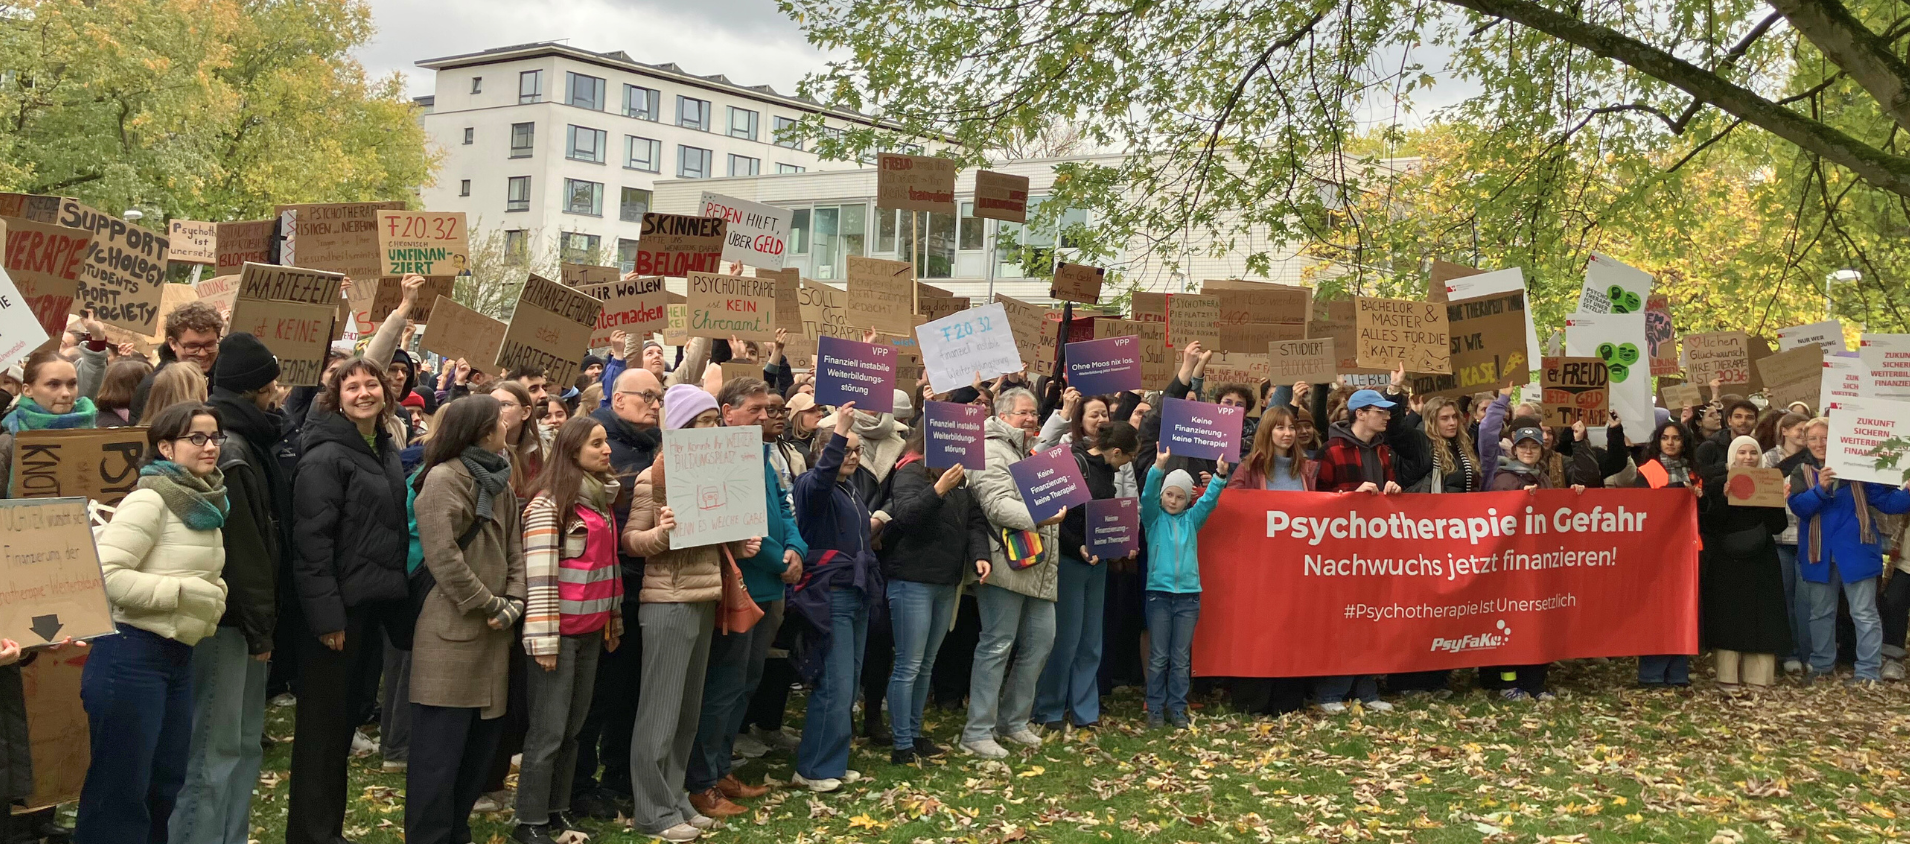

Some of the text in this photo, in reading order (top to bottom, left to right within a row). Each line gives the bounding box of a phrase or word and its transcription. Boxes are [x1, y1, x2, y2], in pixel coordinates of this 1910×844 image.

[641, 213, 722, 238] SKINNER
[705, 202, 780, 235] REDEN HILFT,
[61, 203, 169, 261] SUPPORT
[384, 215, 458, 240] F20.32
[728, 231, 784, 256] ÜBER GELD
[4, 229, 89, 280] HERAPIE
[388, 247, 453, 261] UNFINAN-
[85, 241, 166, 288] YCHOLOGY
[390, 261, 434, 275] ZIERT
[636, 250, 723, 277] BELOHNT
[246, 268, 343, 304] WARTEZEIT
[693, 275, 775, 299] PSYCHOTHERAPIE
[1586, 287, 1608, 300] PSYCHO
[727, 299, 757, 312] KEIN
[934, 299, 950, 311] dich
[1584, 292, 1611, 308] THERAPIE
[79, 301, 158, 326] SOCIETY
[1361, 300, 1414, 314] BACHELOR
[1425, 304, 1439, 323] &
[1372, 313, 1422, 328] MASTER
[275, 318, 321, 343] KEINE
[1361, 328, 1398, 343] ALLES
[1428, 332, 1447, 346] DIE
[1115, 338, 1130, 346] VPP
[1811, 335, 1824, 343] WER
[872, 347, 889, 357] VPP
[1280, 342, 1324, 357] STUDIERT
[1370, 345, 1407, 358] KATZ
[824, 354, 890, 372] Finanziell instabile
[1071, 363, 1091, 371] Ohne
[1091, 361, 1110, 369] Moos
[1110, 358, 1121, 366] nix
[1281, 359, 1326, 377] BLOCKIERT
[1690, 362, 1710, 373] IHRE
[827, 368, 885, 385] Weiterbildungs-
[1714, 369, 1748, 383] 2036
[841, 384, 869, 396] störung
[1576, 391, 1605, 406] GELD
[965, 407, 978, 416] VPP
[1217, 407, 1235, 415] VPP
[1557, 407, 1607, 425] THERAPIE
[929, 418, 980, 431] Finanziell instabile
[1191, 416, 1213, 425] Keine
[1856, 417, 1896, 428] ZUKUNFT
[933, 431, 977, 443] Weiterbildungs-
[1174, 424, 1222, 438] Finanzierung
[1853, 427, 1890, 438] SICHERN
[1172, 434, 1228, 448] keine Therapie!
[944, 445, 966, 456] störung
[1049, 448, 1063, 459] VPP
[1036, 468, 1055, 479] Keine
[1030, 476, 1068, 495] Finanzierung
[1033, 483, 1077, 507] keine Therapie!
[1266, 505, 1647, 545] Psychotherapie in Gefahr
[65, 540, 81, 561] der
[1304, 545, 1617, 581] Nachwuchs jetzt finanzieren!
